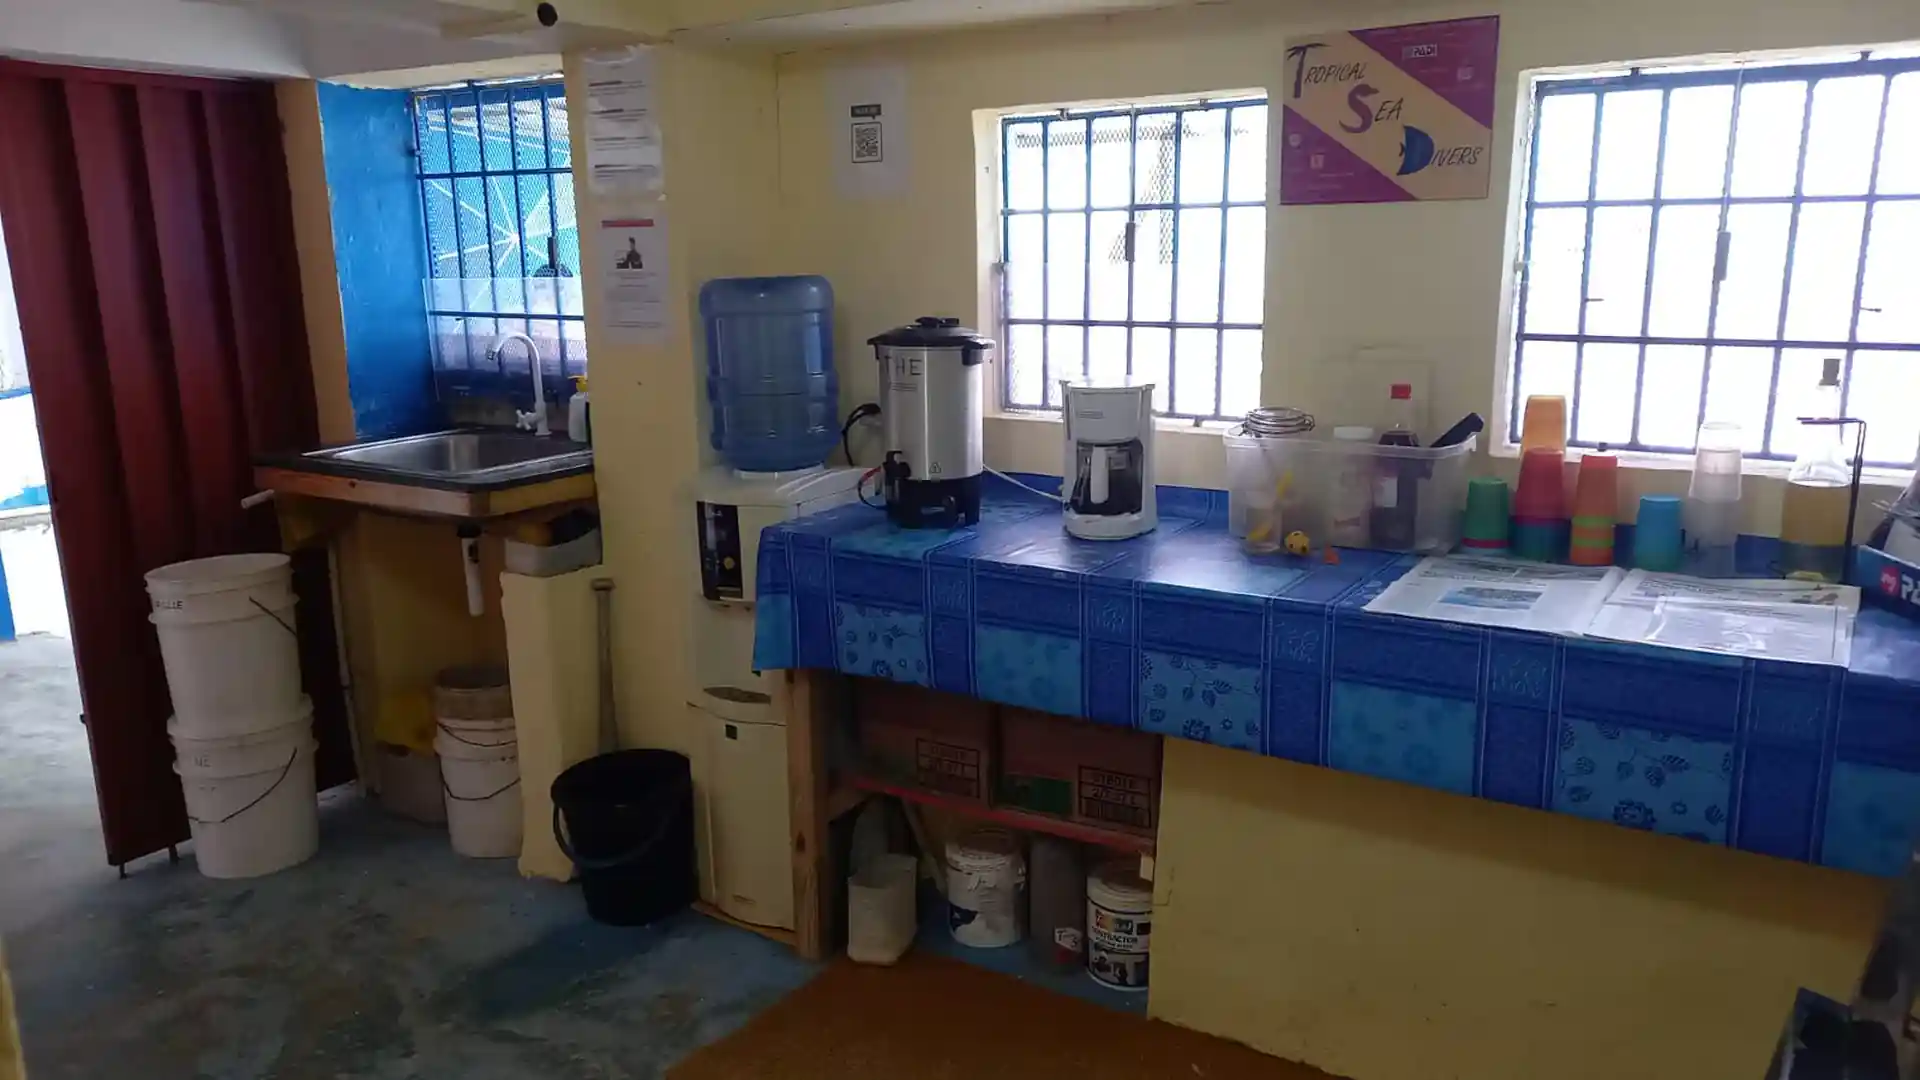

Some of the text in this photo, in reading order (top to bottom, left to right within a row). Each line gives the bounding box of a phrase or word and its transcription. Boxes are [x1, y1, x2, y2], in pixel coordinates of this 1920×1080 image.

[1285, 42, 1367, 99] TROPICAL
[1338, 83, 1404, 134] SEA
[1396, 124, 1484, 176] DIVERS
[884, 354, 923, 376] THE
